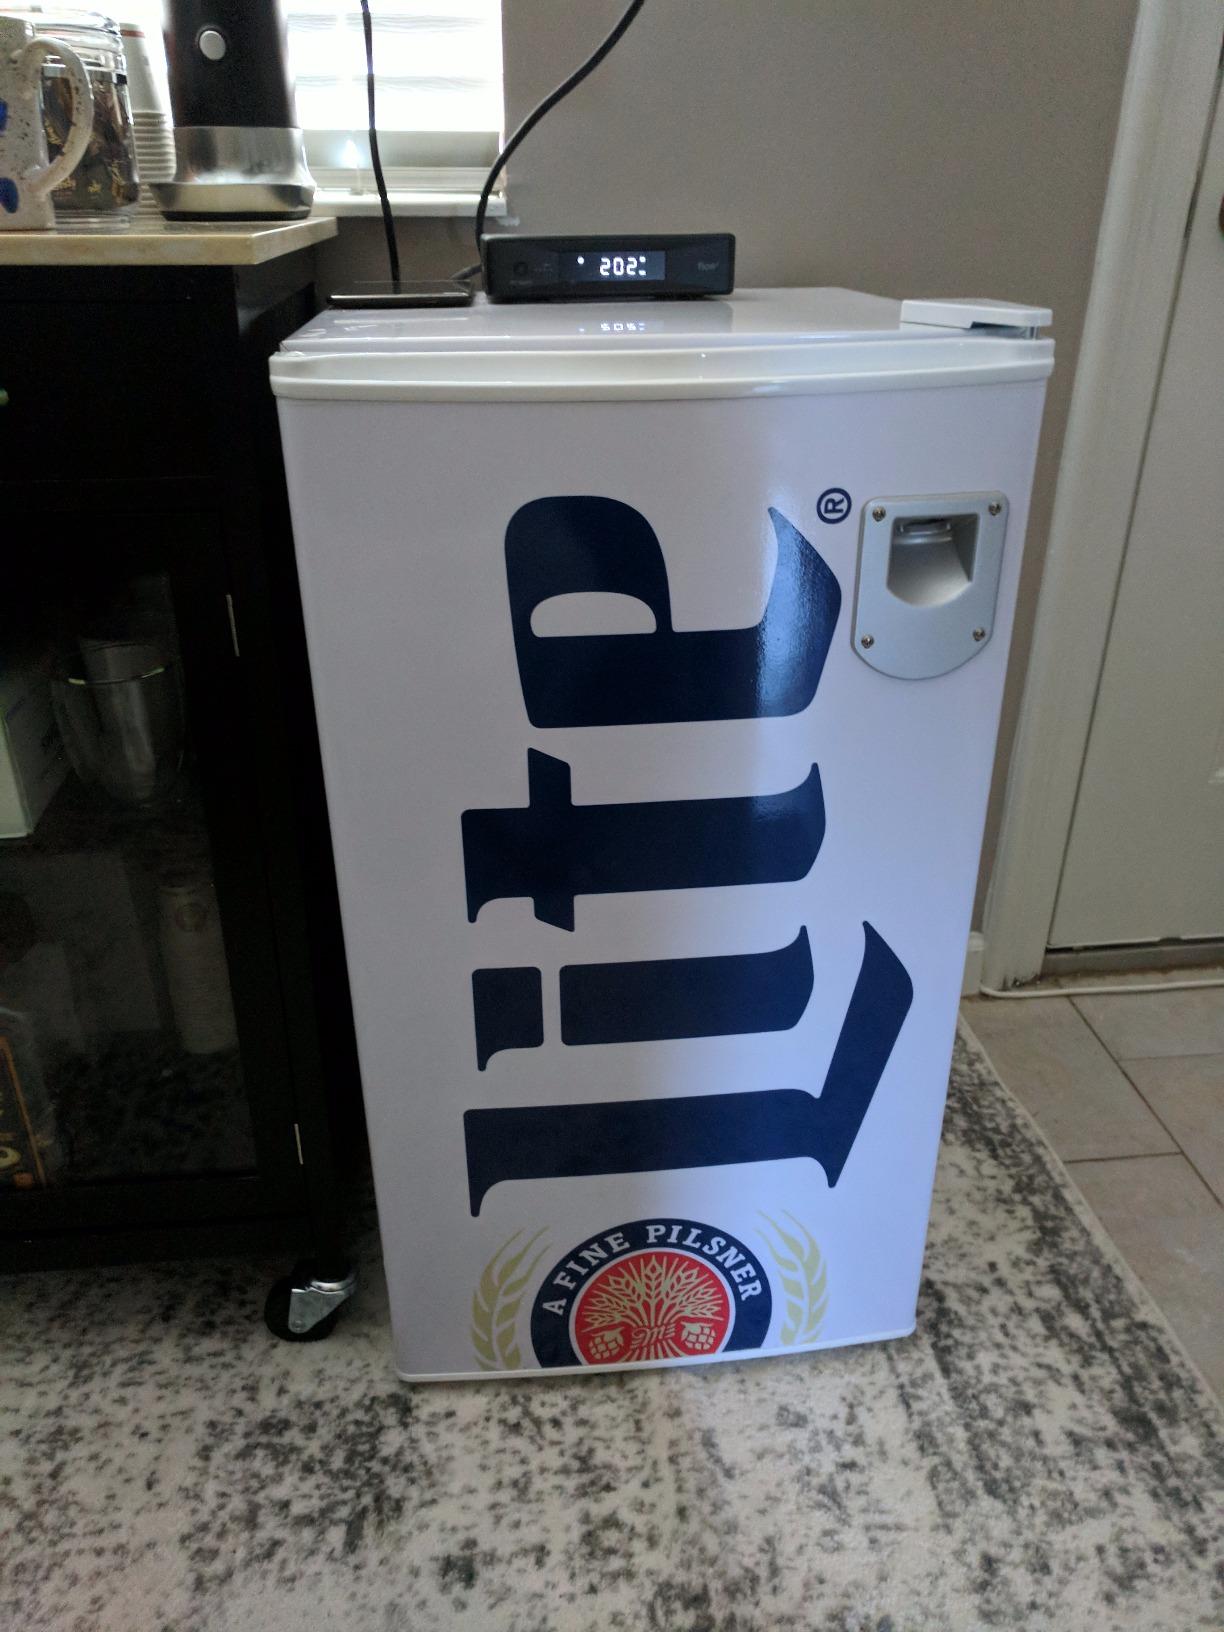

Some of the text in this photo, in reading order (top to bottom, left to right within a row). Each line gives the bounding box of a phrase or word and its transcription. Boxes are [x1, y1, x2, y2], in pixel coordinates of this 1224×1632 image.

[542, 1224, 763, 1316] A FINE PILSNER
